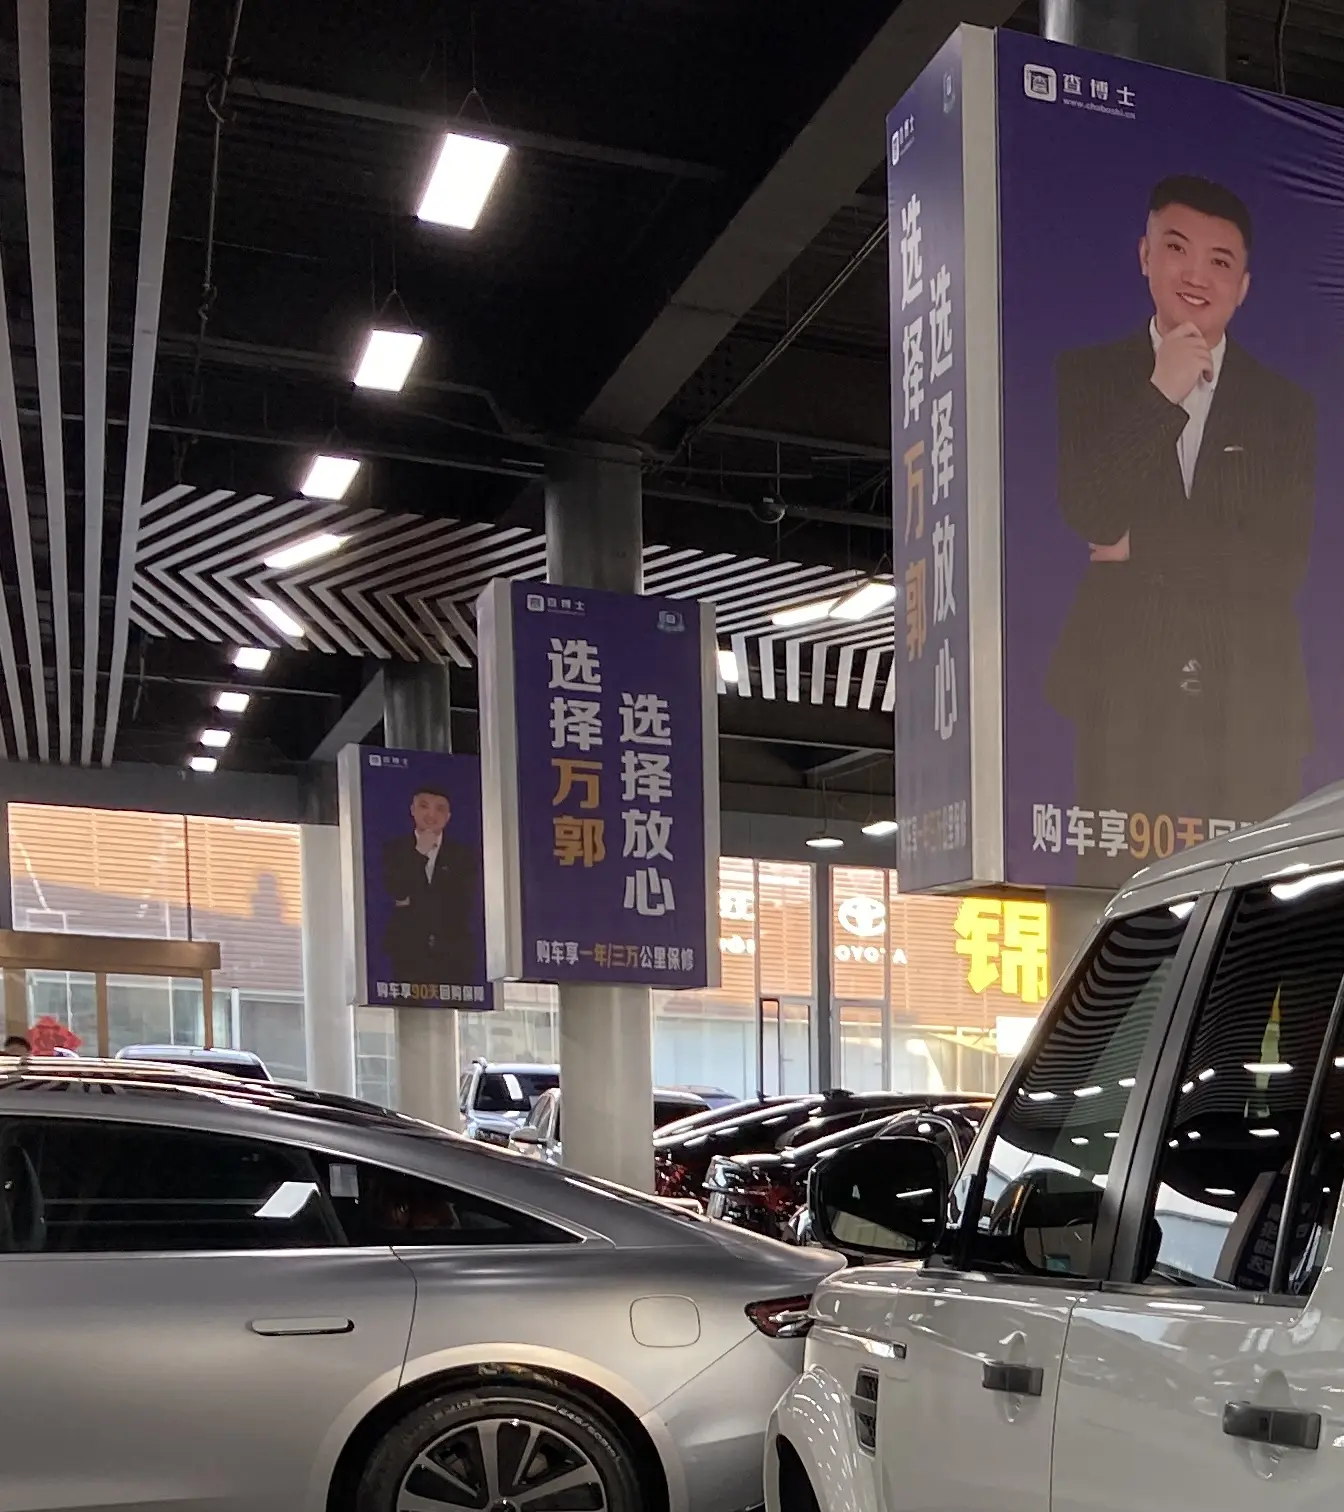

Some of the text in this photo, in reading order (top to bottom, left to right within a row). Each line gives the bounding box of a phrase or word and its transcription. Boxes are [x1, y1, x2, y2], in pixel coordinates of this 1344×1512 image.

[900, 194, 927, 663] 选择万郭
[929, 264, 959, 741] 选择放心
[547, 637, 606, 868] 选择万郭
[619, 692, 676, 917] 选择放心
[953, 896, 1048, 1004] 锦
